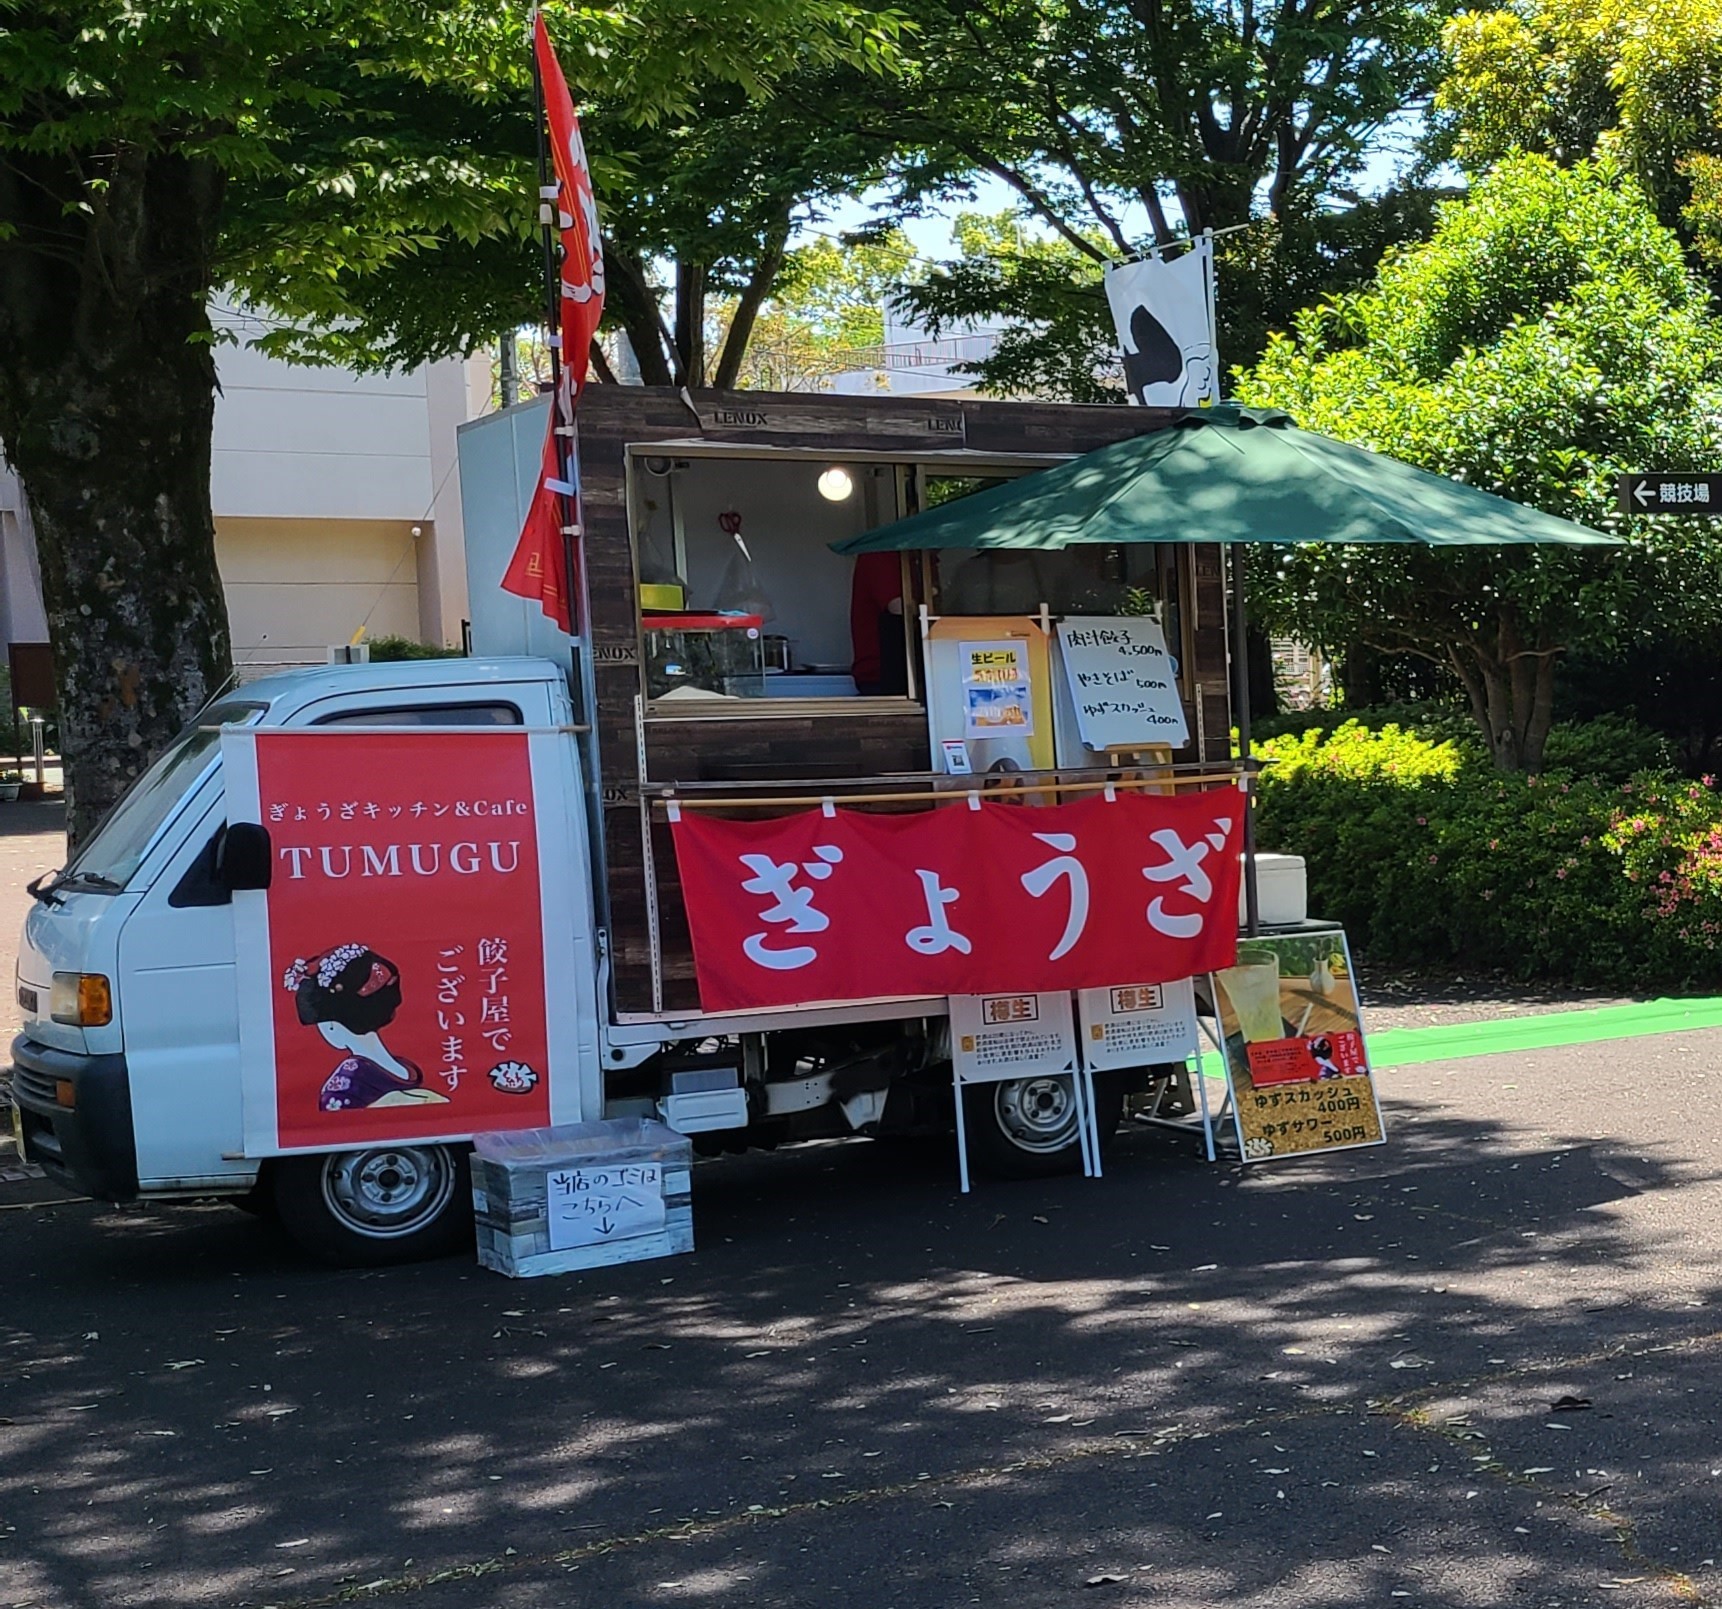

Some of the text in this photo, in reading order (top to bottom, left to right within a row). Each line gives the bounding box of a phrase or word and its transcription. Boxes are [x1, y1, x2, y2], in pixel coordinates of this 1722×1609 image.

[713, 412, 769, 425] LENOX
[1659, 483, 1710, 503] 競技場
[971, 652, 1016, 665] 生ビール
[268, 799, 528, 822] ぎょうざキッチン&Cafe
[280, 841, 521, 880] TUMUGU
[738, 817, 1232, 970] ぎょうざ
[478, 937, 512, 1051] 餃子屋で
[436, 944, 468, 1092] ございます
[1254, 1087, 1353, 1109] ゆずスカッシュ
[1317, 1096, 1360, 1113] 400円
[1262, 1118, 1333, 1137] ゆずサワー
[1323, 1125, 1366, 1143] 500円
[552, 1168, 656, 1196] 当店のゴミは
[561, 1195, 644, 1220] こちらへ
